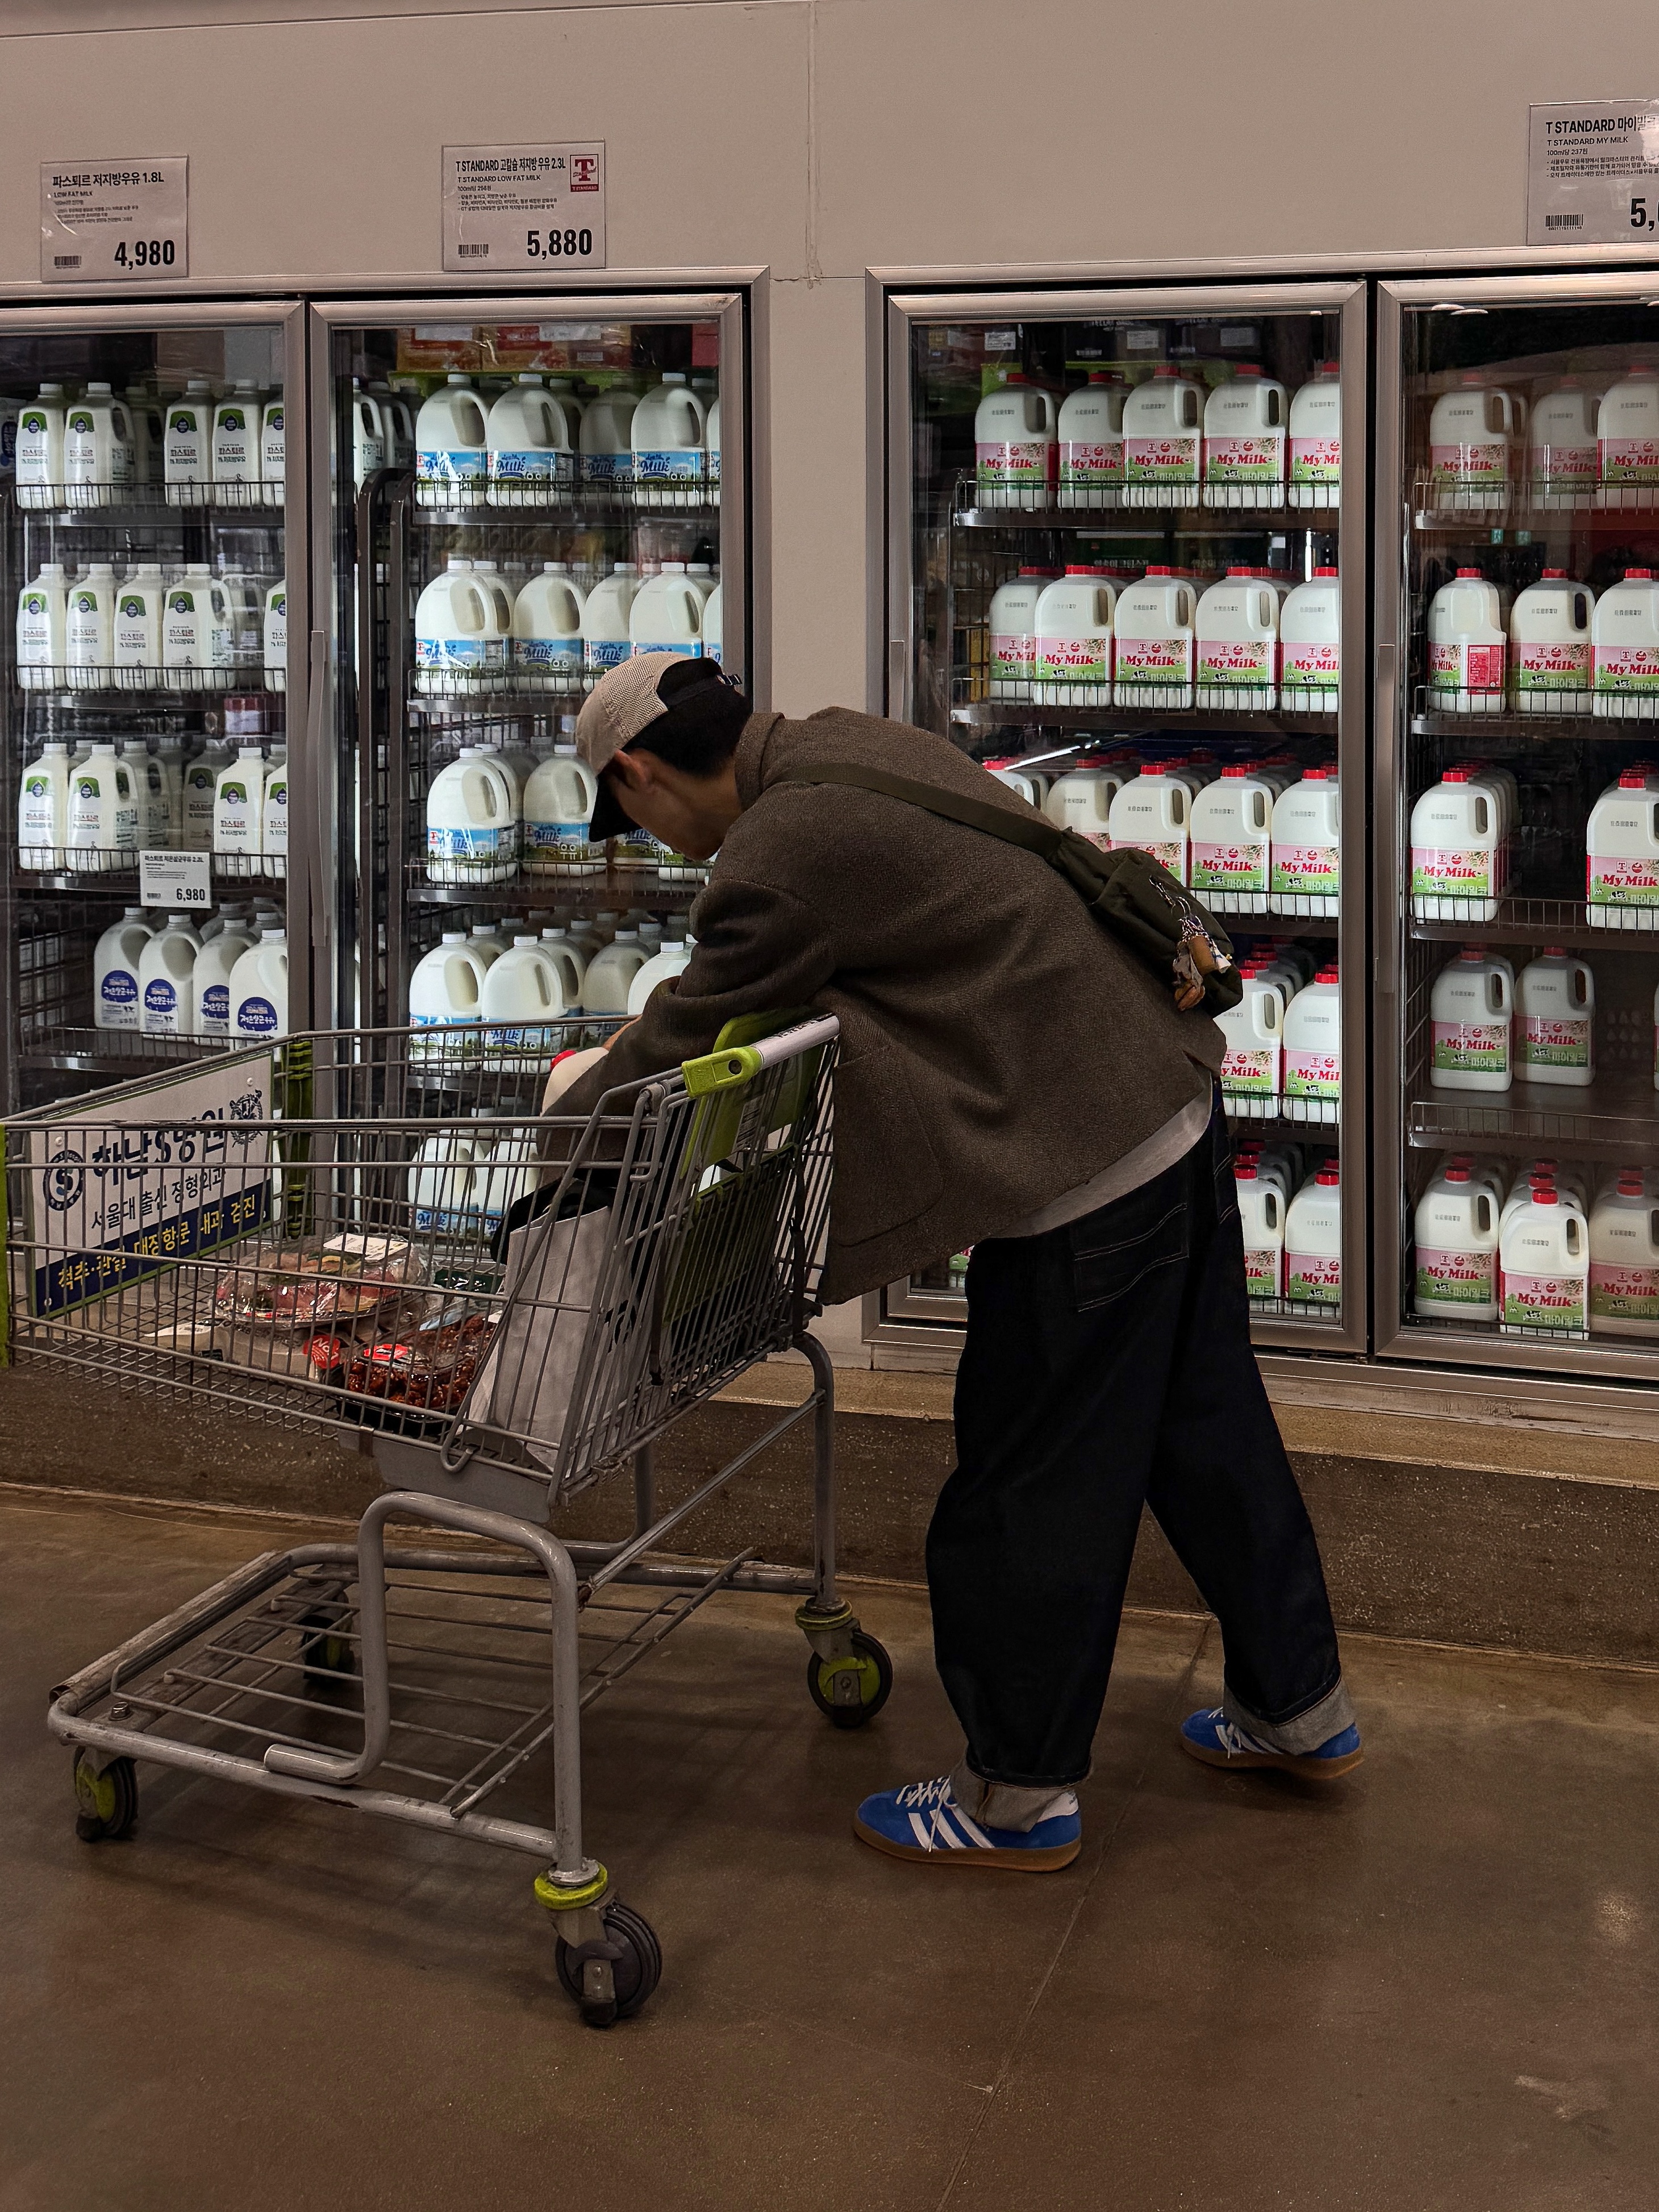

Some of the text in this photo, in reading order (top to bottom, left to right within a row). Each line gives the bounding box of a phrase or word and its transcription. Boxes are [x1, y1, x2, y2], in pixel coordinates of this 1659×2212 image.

[1546, 122, 1553, 134] T
[1554, 119, 1615, 134] STANDARD
[1553, 138, 1595, 147] STANDARD
[456, 157, 566, 172] T STANDARD 고칼슘 저지방 우유 2.3L
[52, 171, 165, 189] 파스퇴르 저지방우유 1.8L
[1631, 198, 1659, 231] 5,
[527, 228, 593, 260] 5,880
[114, 239, 175, 270] 4,980
[986, 457, 1033, 469] My Milk
[1072, 457, 1117, 469] My Milk
[1136, 455, 1184, 466] My Milk
[1218, 453, 1266, 465] My Milk
[1303, 455, 1340, 465] My Mi
[1615, 455, 1659, 467] My Mil
[498, 460, 526, 472] Milk
[640, 460, 670, 472] Milk
[998, 651, 1035, 662] My Mil
[1046, 653, 1094, 665] My Milk
[1126, 655, 1175, 667] My Milk
[1208, 657, 1257, 669] My Milk
[1295, 659, 1339, 670] My Mil
[1524, 659, 1576, 671] My Milk
[1607, 664, 1627, 676] My
[1203, 859, 1252, 872] My Milk
[1281, 860, 1332, 874] My Milk
[1424, 866, 1476, 878] My Milk
[1602, 873, 1658, 887] My Milk
[176, 888, 206, 902] 6,980
[1447, 1038, 1495, 1050] My Milk
[1527, 1033, 1576, 1045] My Milk
[1229, 1066, 1261, 1077] Milk
[1298, 1068, 1339, 1081] My Mil
[91, 1168, 226, 1229] 서울대 출신 정형외과
[1245, 1265, 1263, 1277] ilk
[1428, 1267, 1479, 1280] My Milk
[1302, 1272, 1339, 1284] My Mi
[1603, 1282, 1657, 1296] My Milk
[1518, 1293, 1571, 1307] My Milk
